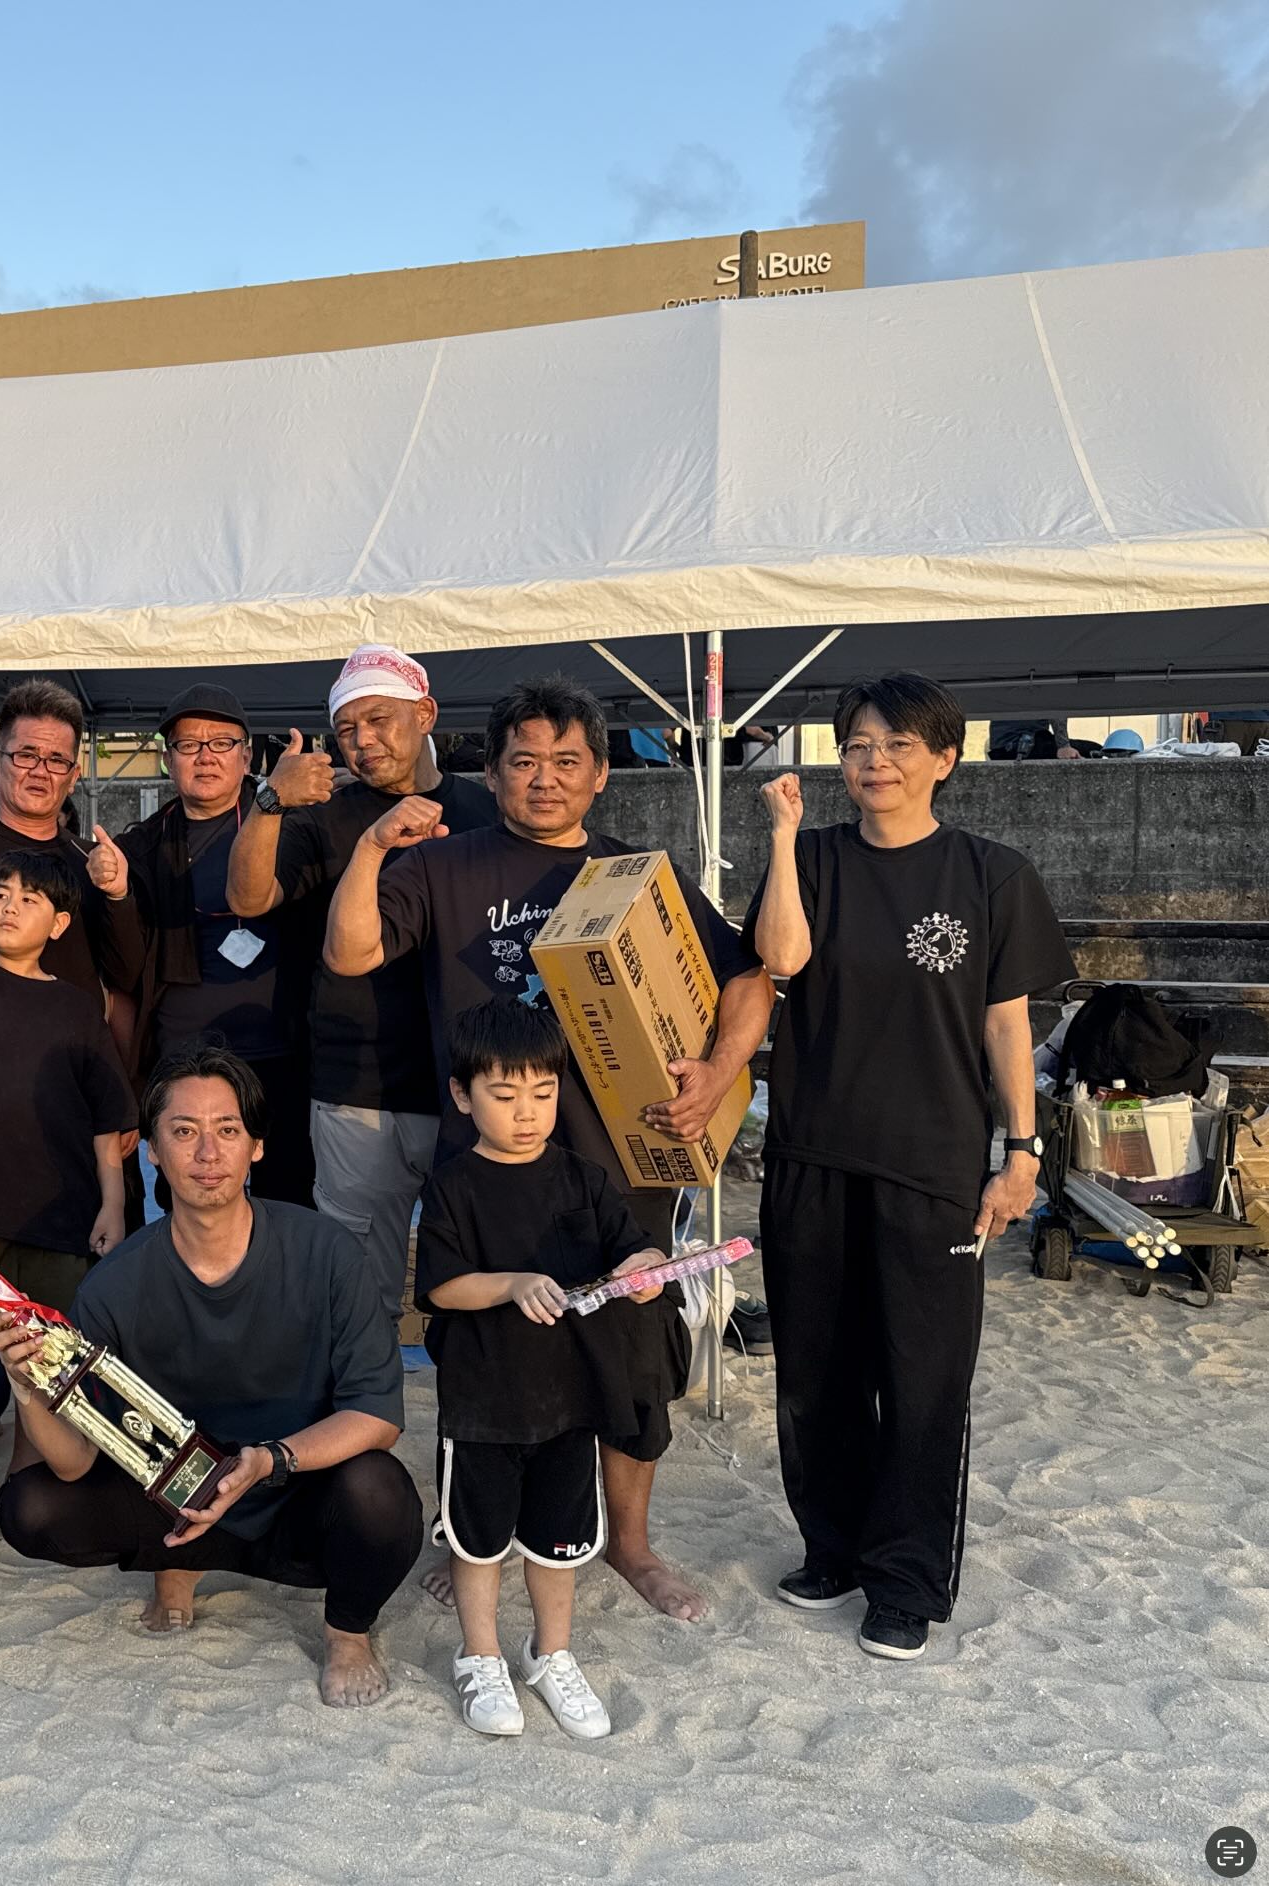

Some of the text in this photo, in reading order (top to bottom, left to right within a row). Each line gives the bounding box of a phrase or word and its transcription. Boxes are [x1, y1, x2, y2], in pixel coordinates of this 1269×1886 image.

[486, 899, 553, 933] Uchin
[589, 952, 613, 986] S&B
[618, 936, 640, 987] 19134
[675, 948, 709, 1026] BETTOLA
[581, 1003, 598, 1017] LA
[588, 1021, 621, 1070] BETTOLA
[673, 1148, 698, 1181] 19134
[553, 1541, 591, 1557] FILA
